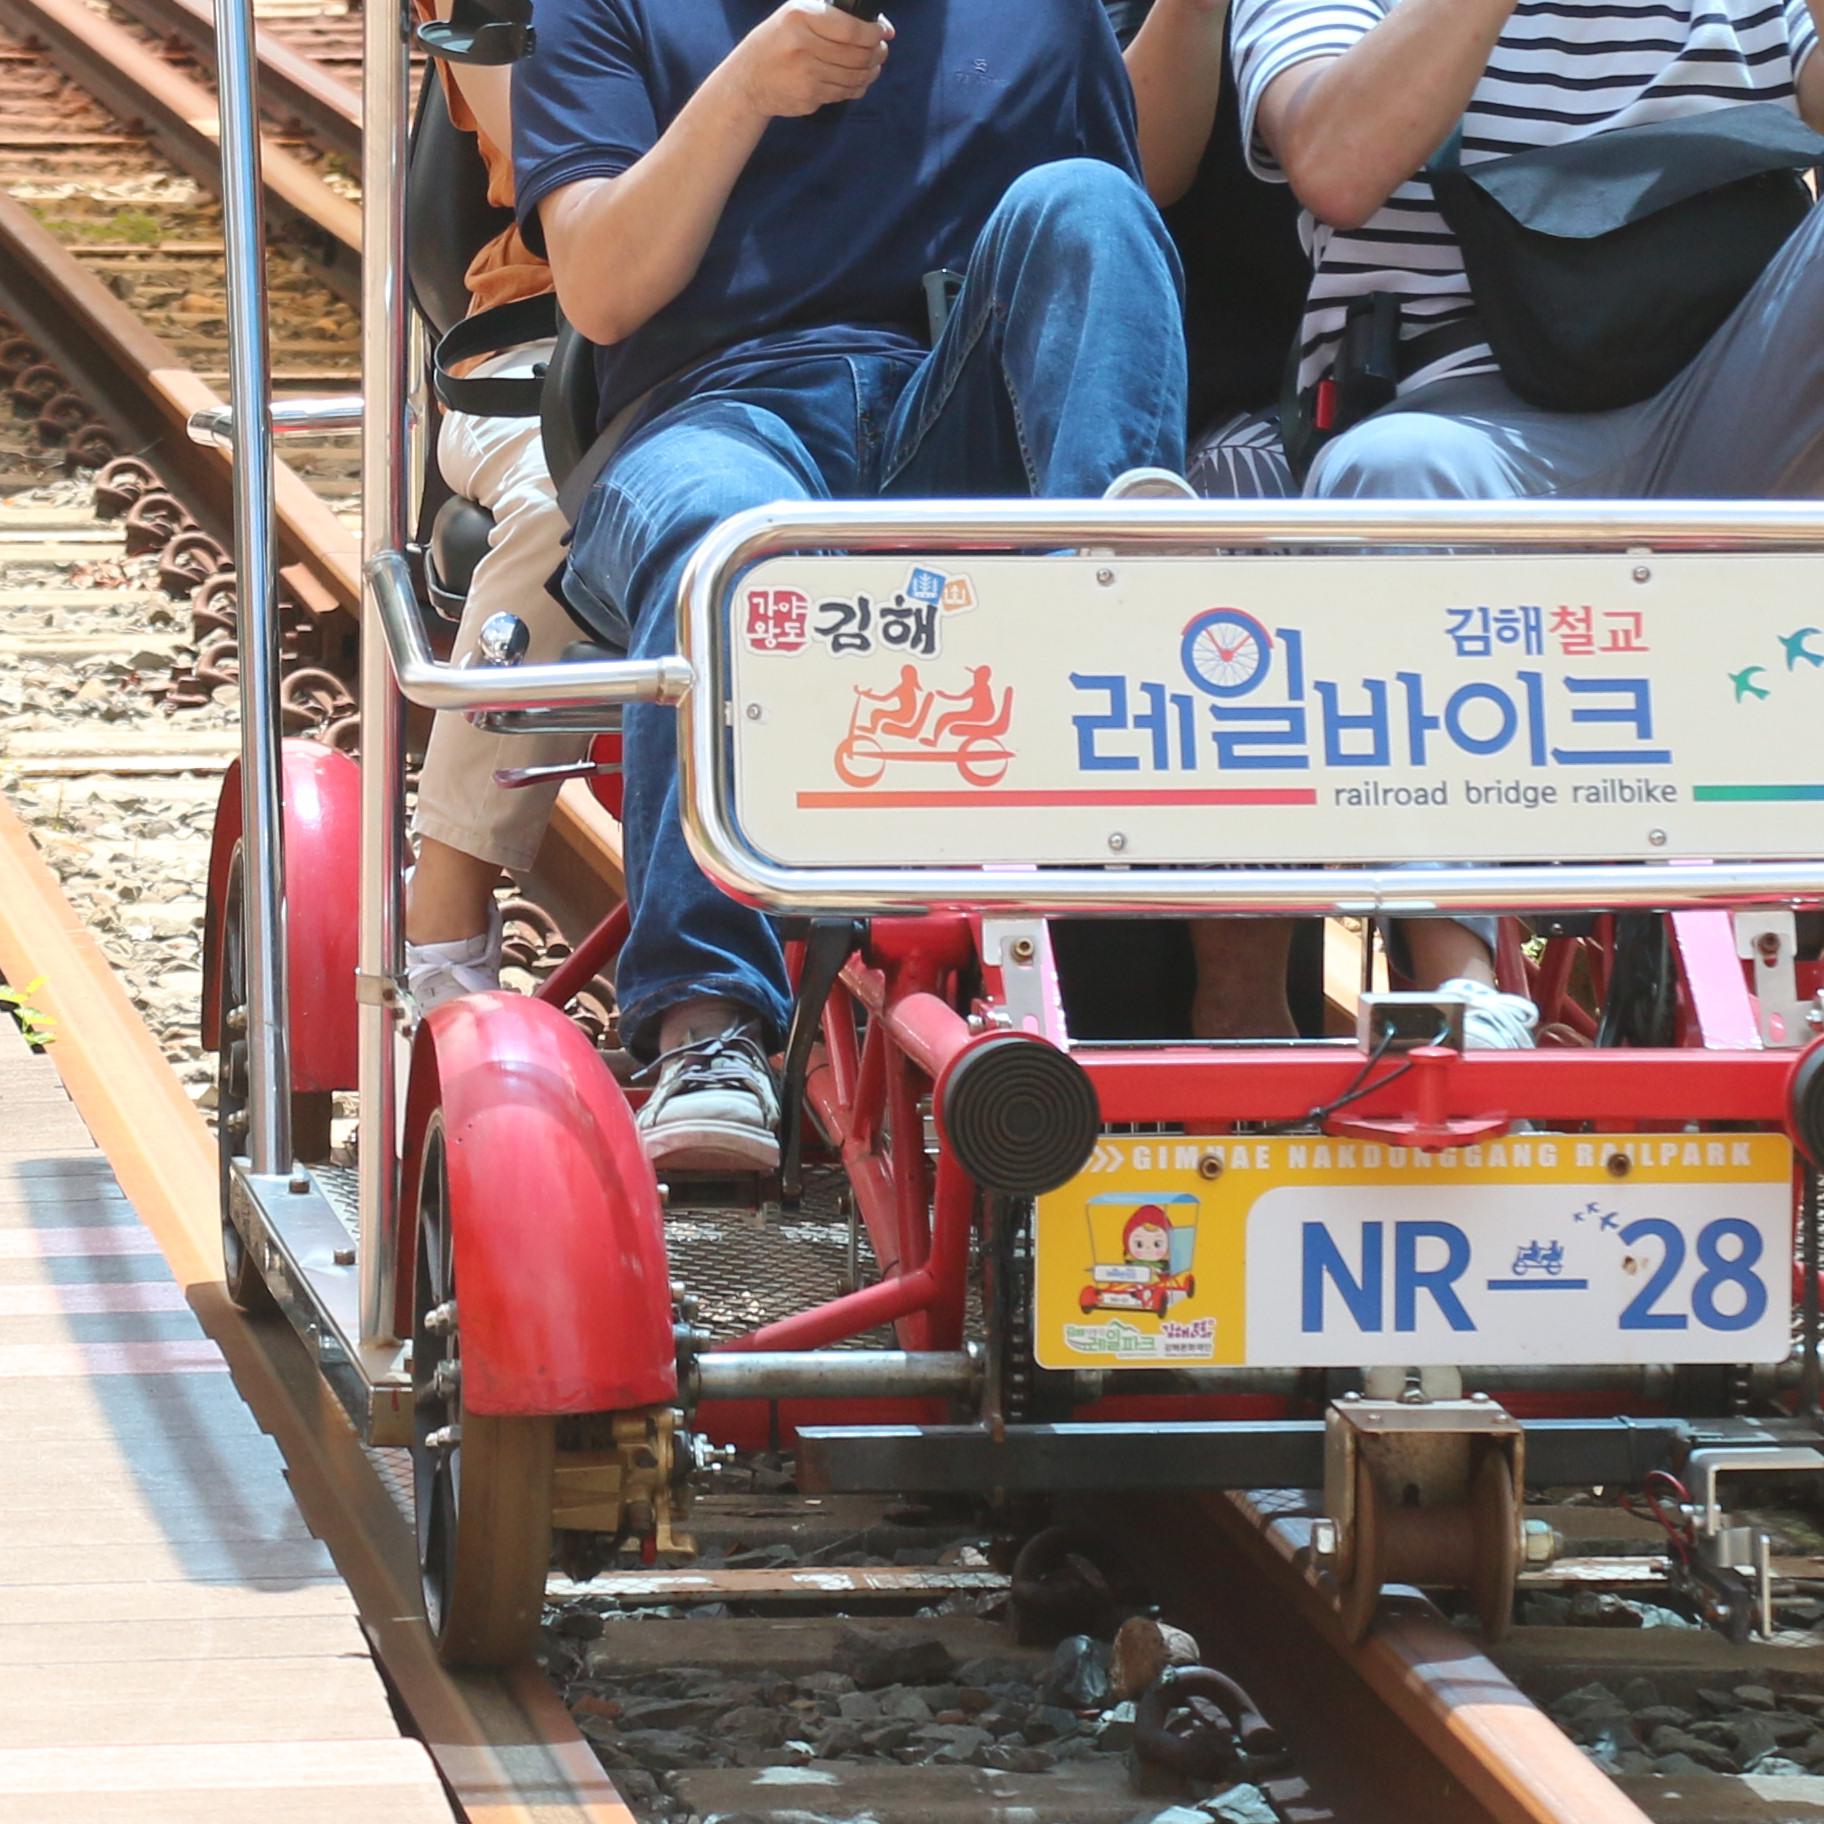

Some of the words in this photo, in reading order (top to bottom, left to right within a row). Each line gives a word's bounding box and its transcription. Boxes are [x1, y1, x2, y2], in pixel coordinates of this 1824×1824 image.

[751, 590, 808, 617] 가야
[746, 619, 808, 649] 왕도
[813, 594, 939, 655] 김해
[1070, 607, 1673, 772] 레일바이크
[1334, 780, 1449, 807] railroad
[1464, 779, 1558, 809] bridge
[1571, 778, 1678, 805] railbike
[1288, 1142, 1558, 1169] NAKDONGGANG
[1575, 1141, 1752, 1168] RAILPARK
[1301, 1221, 1478, 1333] NR
[1618, 1216, 1769, 1331] 28
